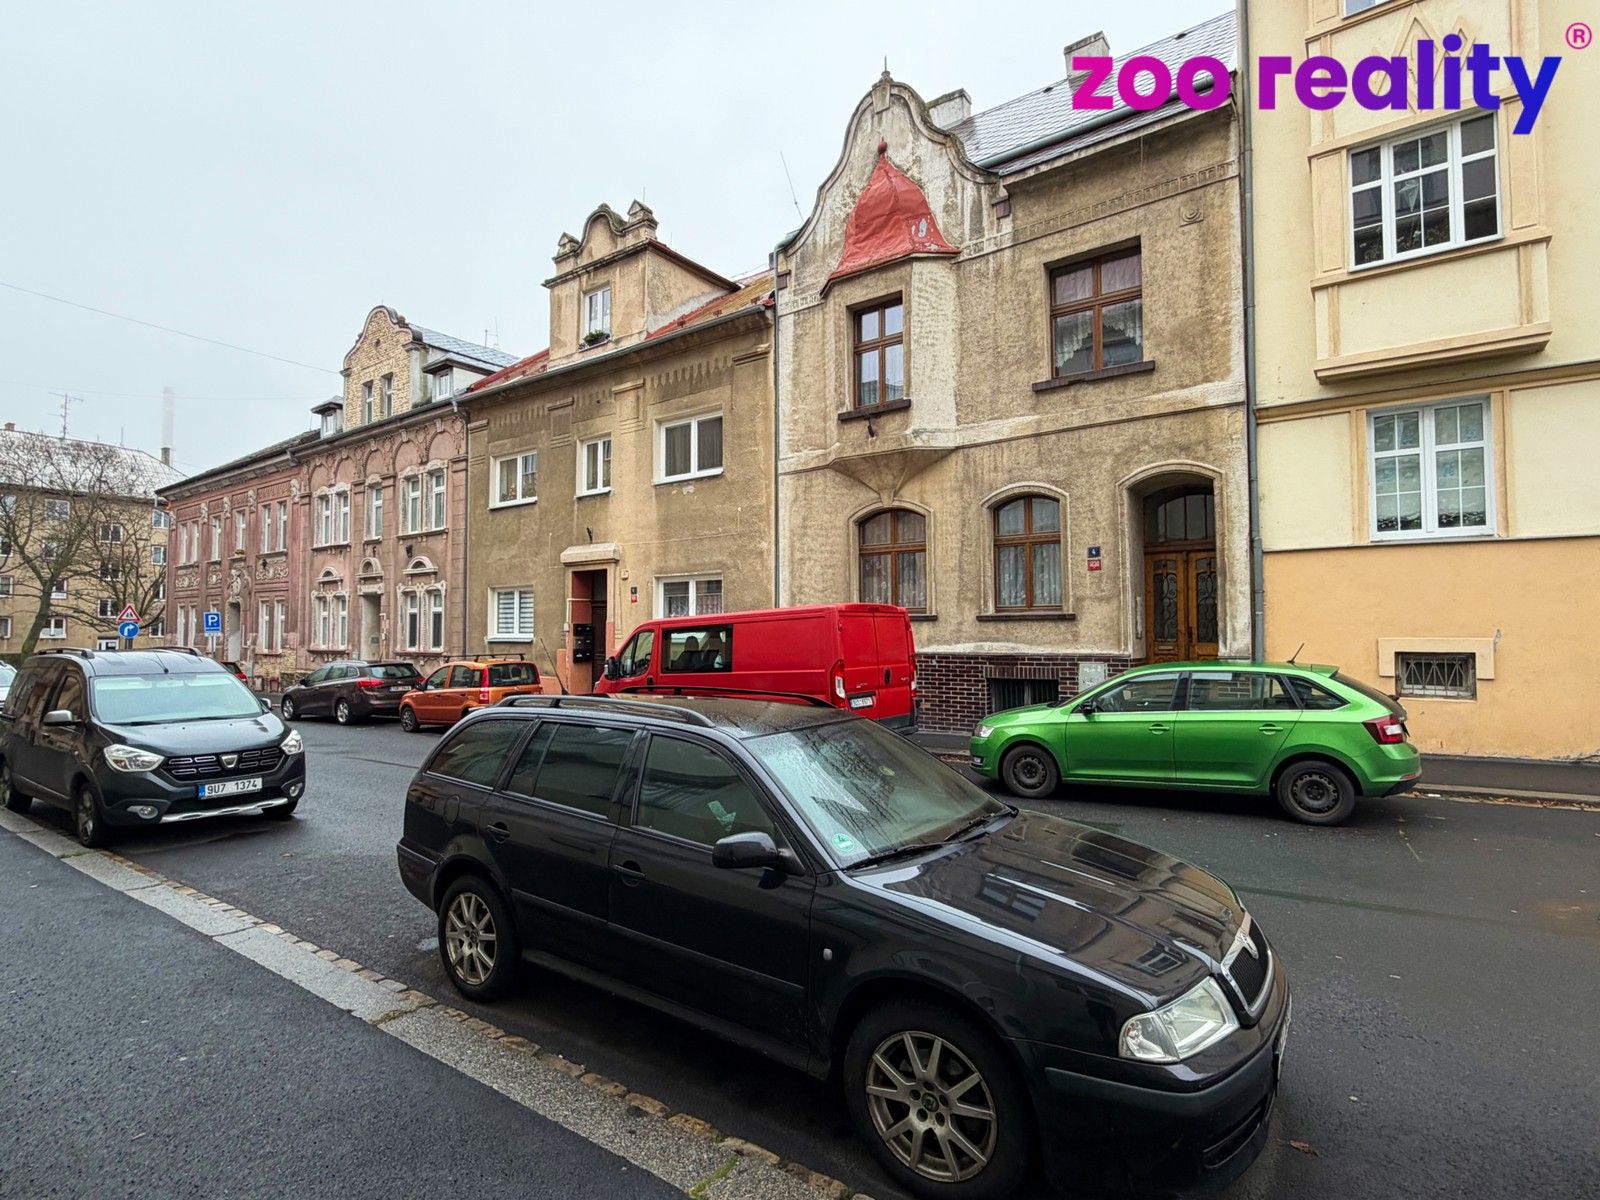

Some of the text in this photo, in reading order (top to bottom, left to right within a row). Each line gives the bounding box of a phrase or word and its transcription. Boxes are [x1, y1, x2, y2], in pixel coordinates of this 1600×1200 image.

[208, 614, 218, 626] P
[207, 780, 258, 795] 9U7 1374
